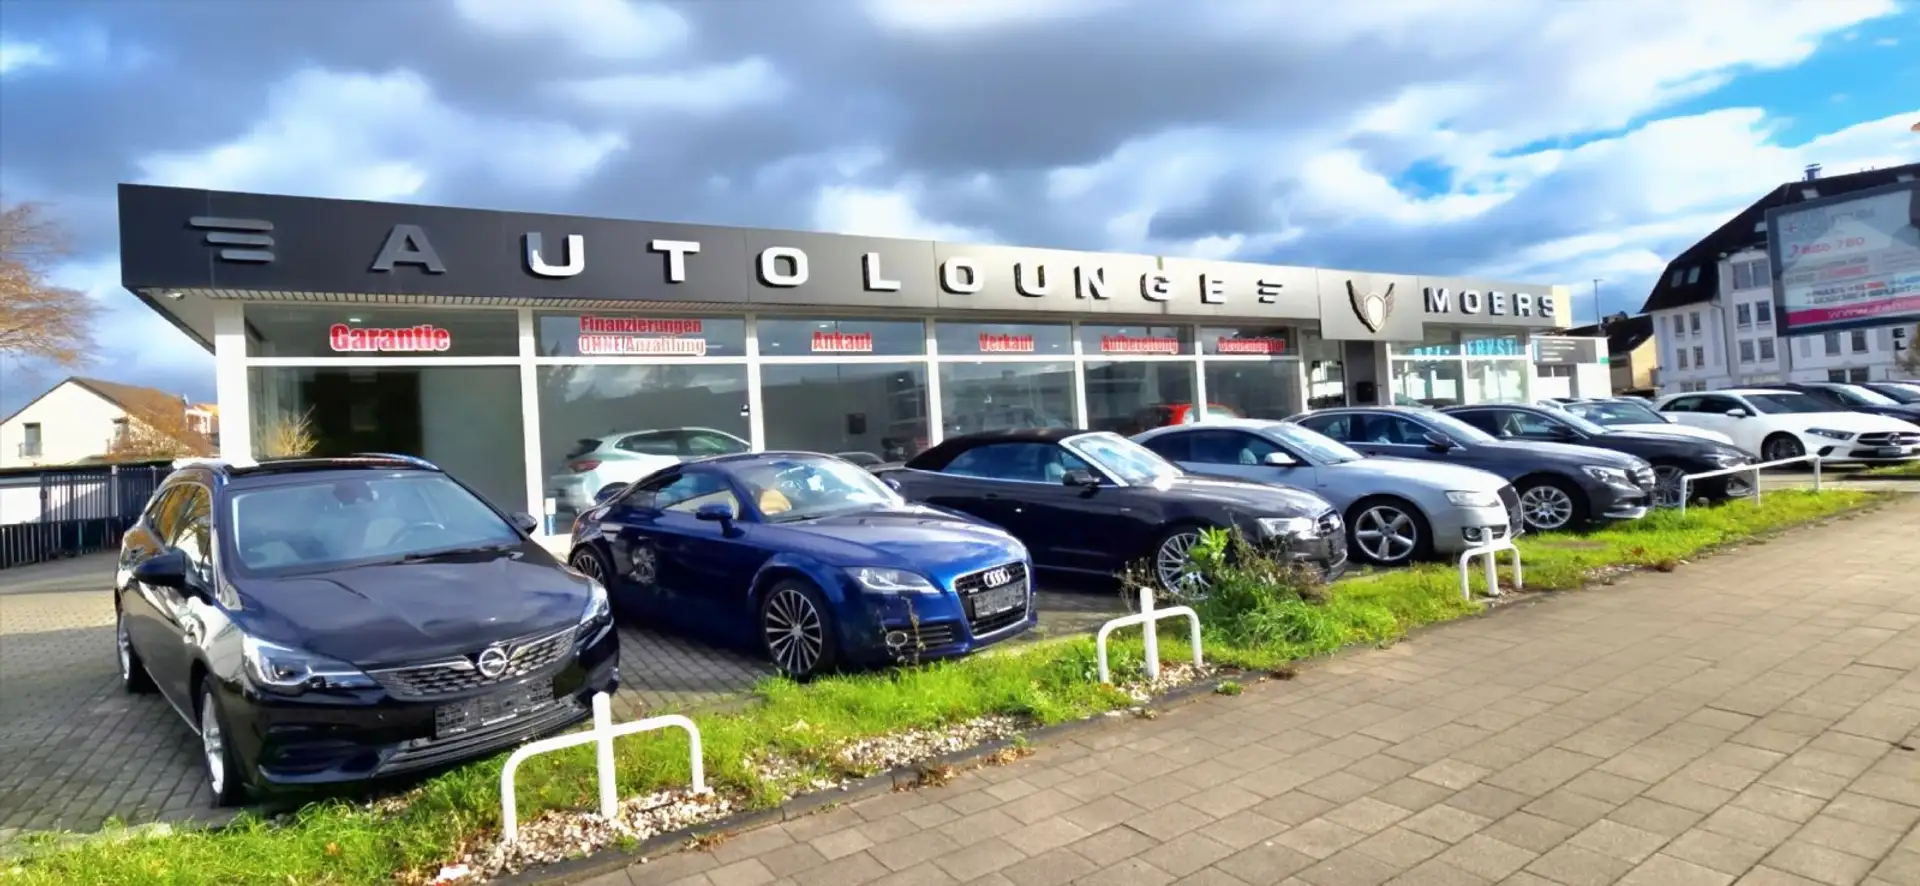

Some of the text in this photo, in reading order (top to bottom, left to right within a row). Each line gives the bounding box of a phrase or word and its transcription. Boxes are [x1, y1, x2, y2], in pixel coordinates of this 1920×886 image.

[1423, 286, 1555, 318] MOERS
[579, 315, 703, 335] Finanzierungen
[329, 323, 450, 352] Garantie
[579, 335, 622, 354] OHNE
[811, 331, 873, 352] Ankauf
[979, 332, 1035, 352] Verkauf
